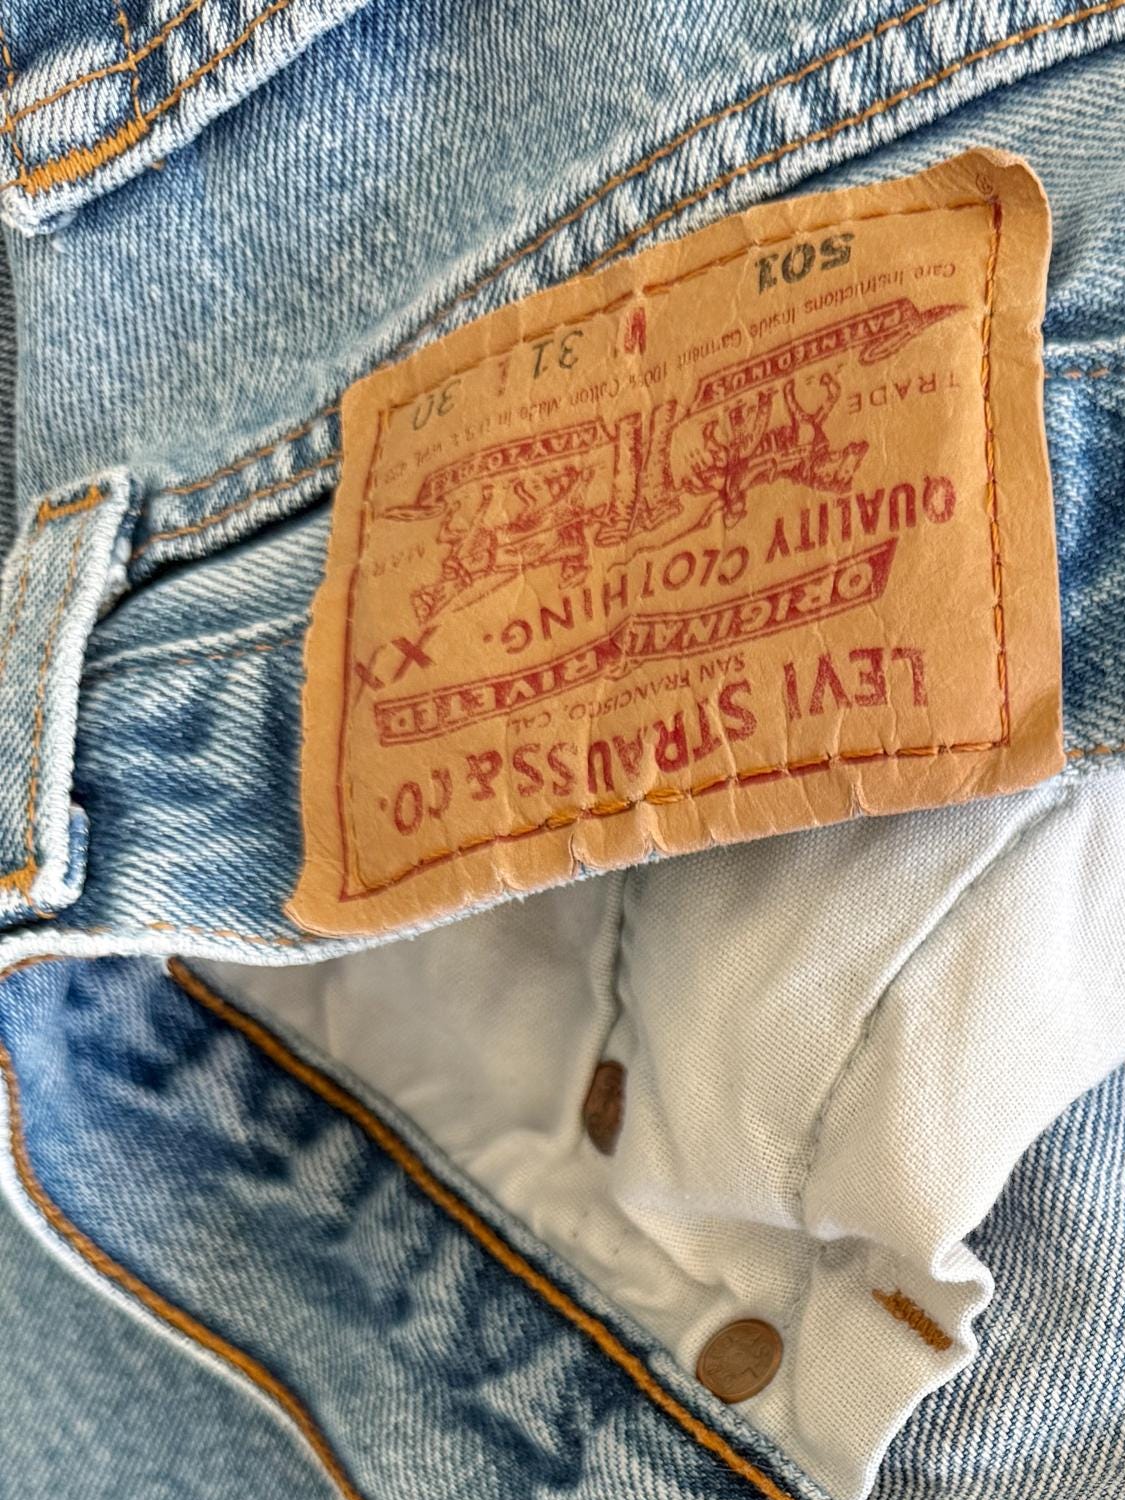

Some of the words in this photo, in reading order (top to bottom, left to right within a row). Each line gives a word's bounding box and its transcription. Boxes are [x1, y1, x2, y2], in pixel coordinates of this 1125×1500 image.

[753, 230, 854, 296] 501
[913, 262, 956, 279] Care
[804, 268, 903, 314] Instructions
[748, 306, 794, 338] Inside
[776, 308, 903, 372] PATENTED
[531, 329, 583, 379] 31
[676, 329, 740, 371] Garment
[750, 358, 772, 382] IN
[846, 371, 959, 415] TRADE
[535, 426, 592, 460] MAY
[764, 474, 953, 563] QUALITY
[629, 560, 872, 649] ORIGINAL
[351, 624, 438, 709] XX
[388, 646, 595, 733] RIVETED
[697, 652, 743, 683] SAN
[782, 645, 929, 722] LEVI
[377, 767, 452, 834] CO.
